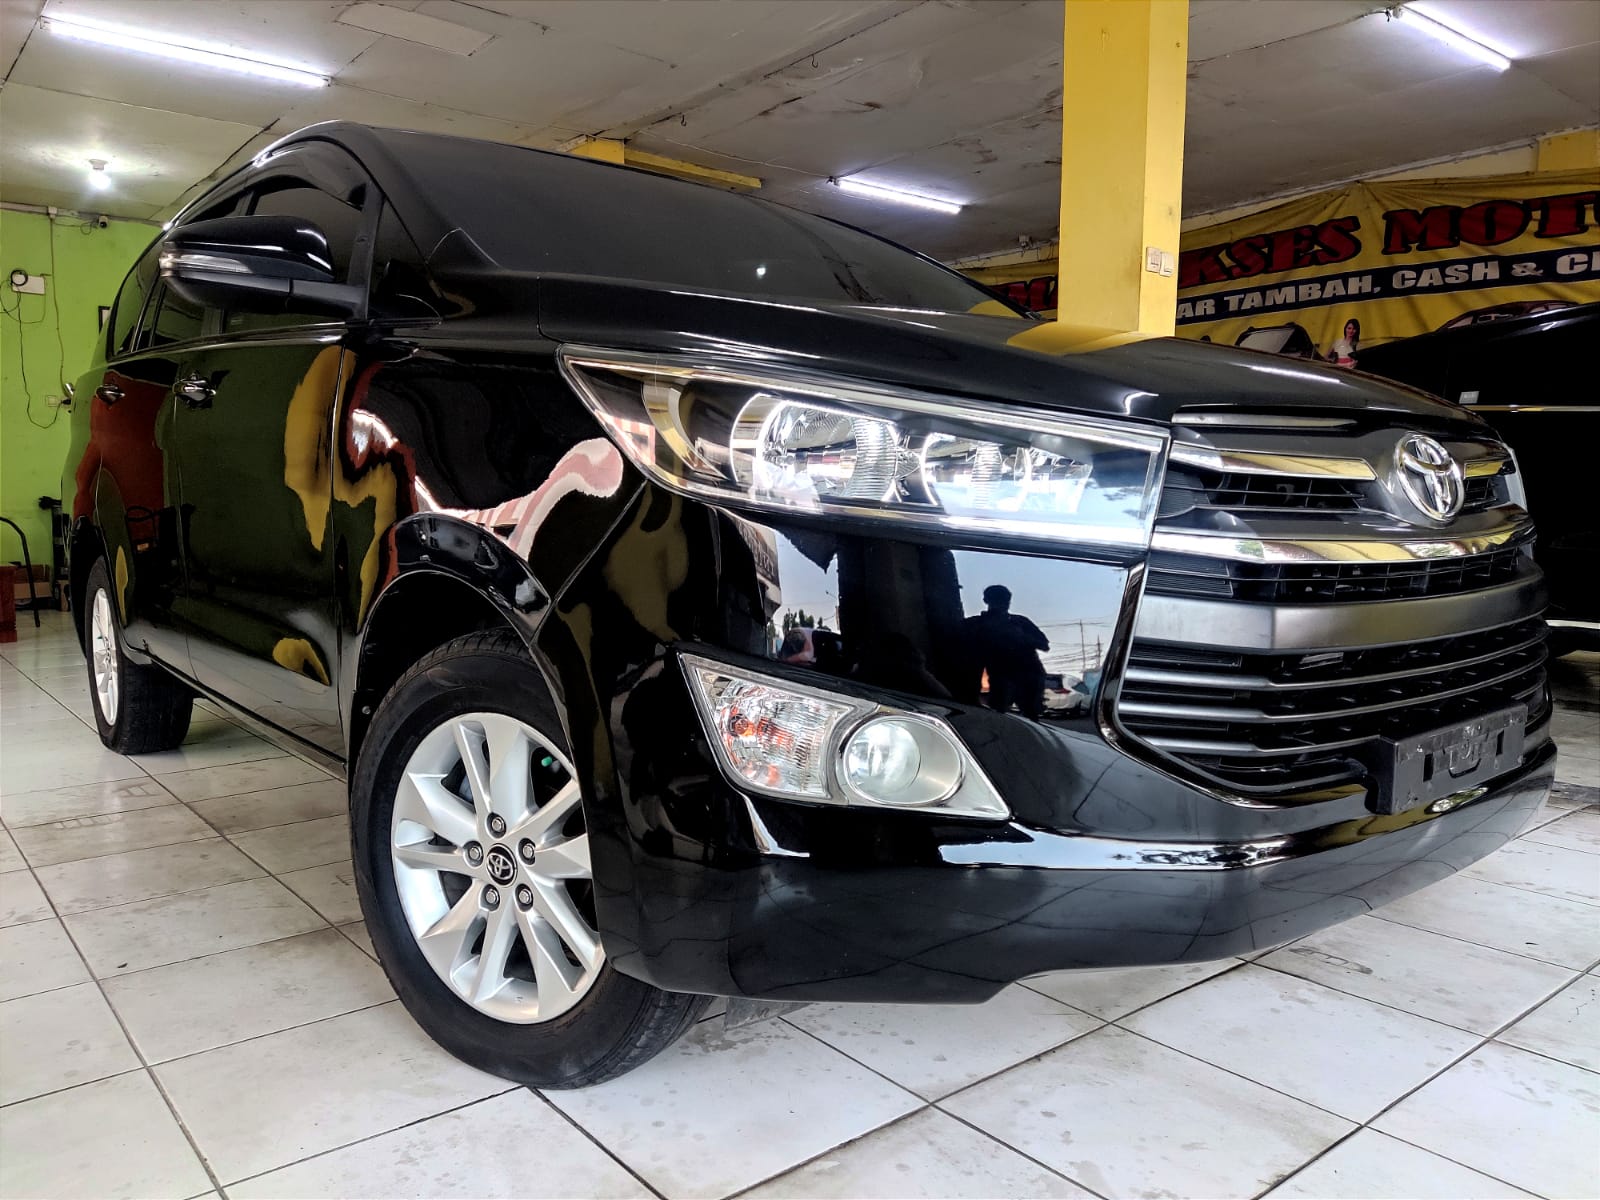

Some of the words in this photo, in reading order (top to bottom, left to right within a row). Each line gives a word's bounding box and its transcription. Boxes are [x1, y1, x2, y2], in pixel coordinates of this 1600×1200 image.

[1178, 215, 1362, 288] KSES
[1382, 191, 1600, 255] MOT
[1177, 298, 1215, 319] AR
[1224, 275, 1381, 312] TAMBAH,
[1392, 260, 1500, 289] CASH
[1511, 262, 1544, 277] &
